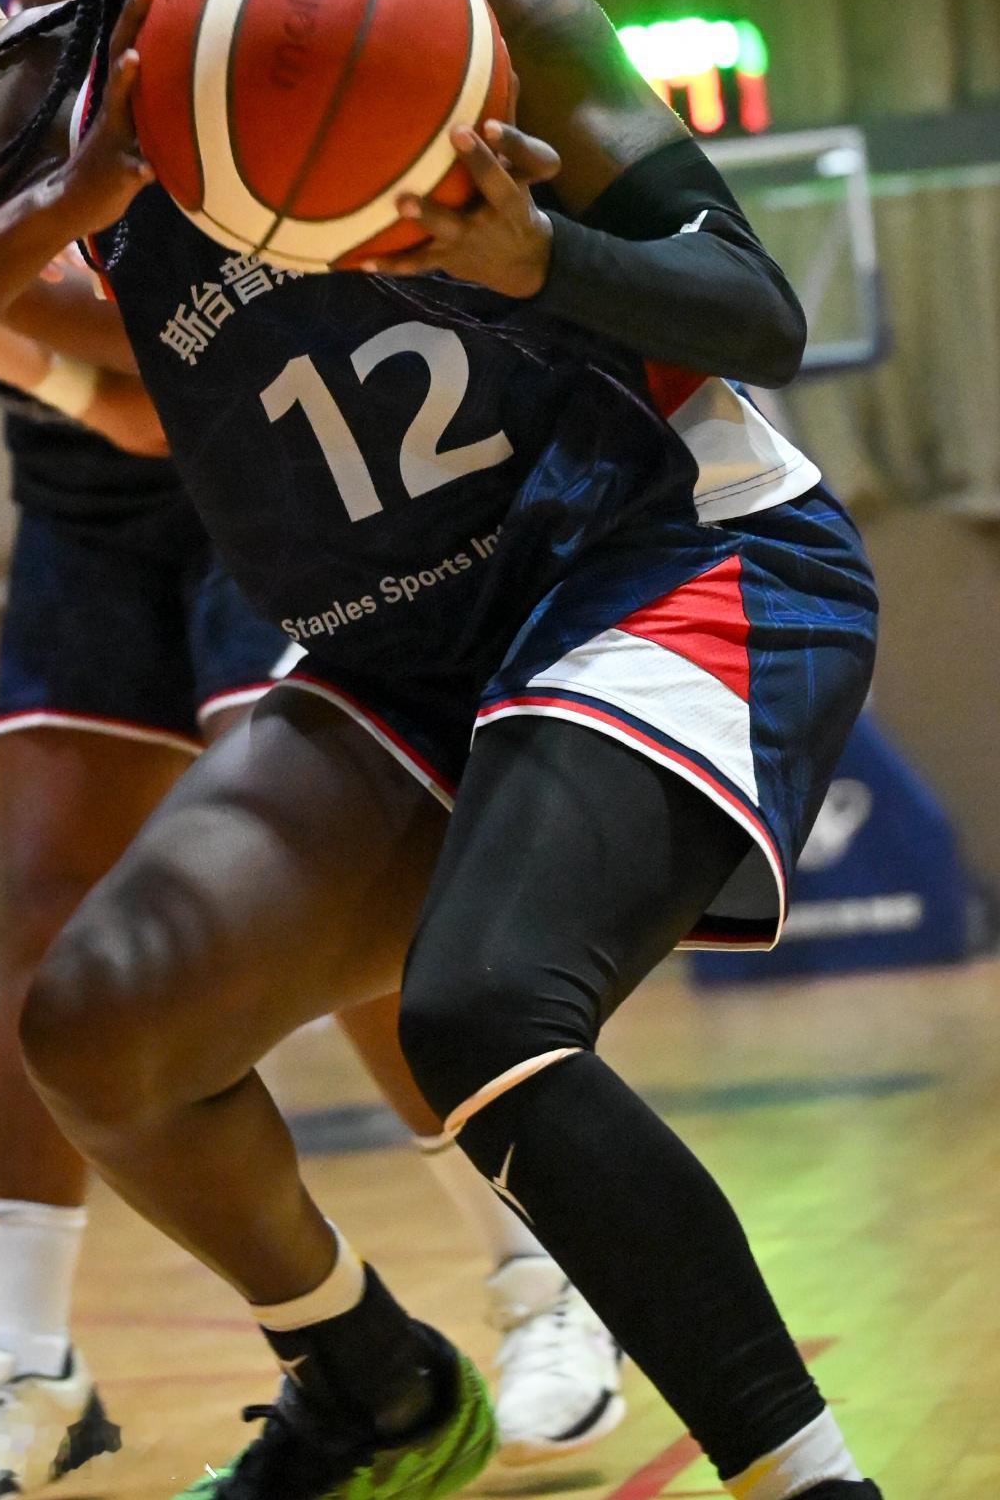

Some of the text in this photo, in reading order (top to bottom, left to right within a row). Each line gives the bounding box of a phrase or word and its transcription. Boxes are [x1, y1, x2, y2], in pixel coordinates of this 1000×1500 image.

[159, 251, 305, 367] 斯台普
[259, 320, 514, 523] 12
[281, 594, 377, 643] Staples
[379, 552, 473, 604] Sports
